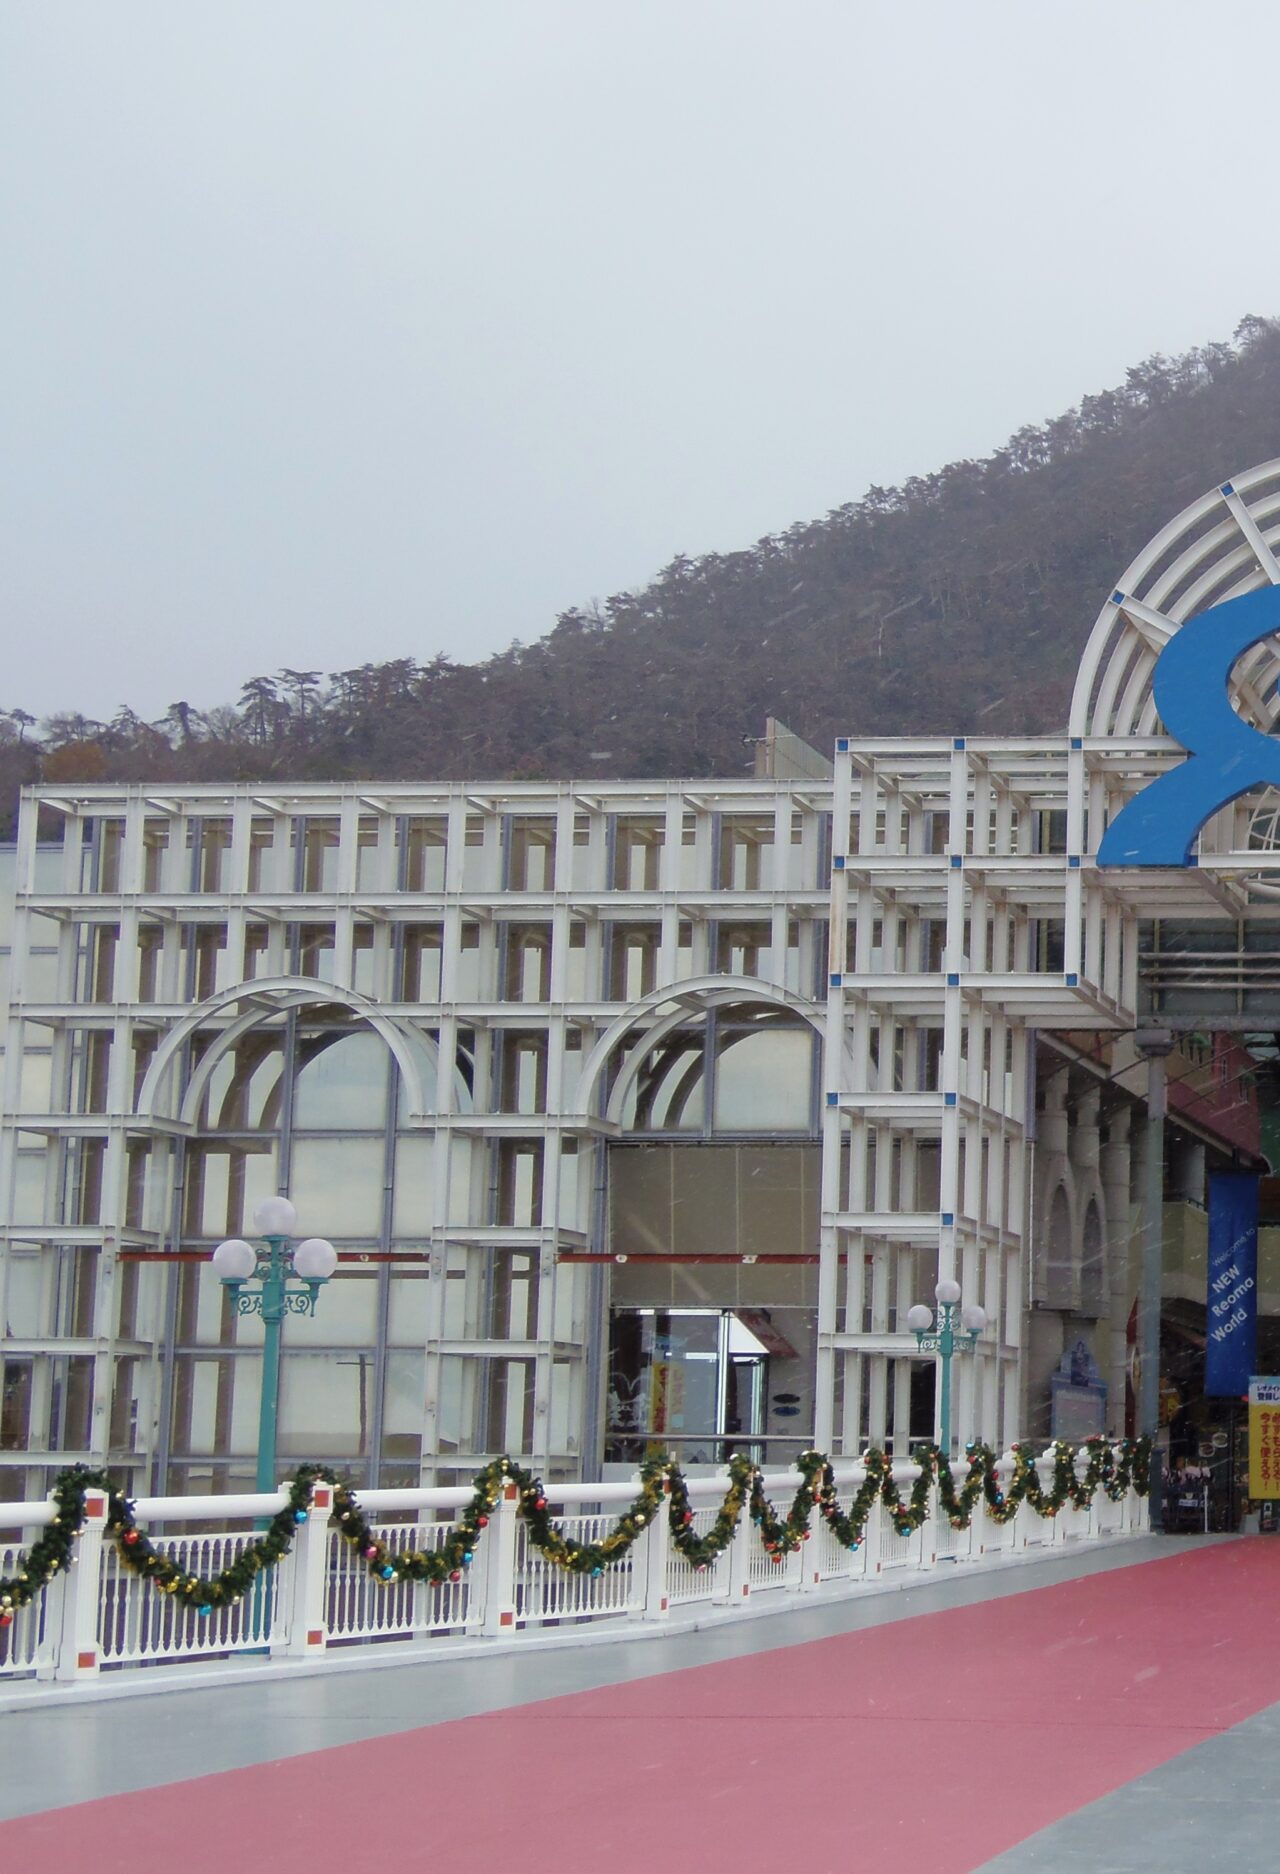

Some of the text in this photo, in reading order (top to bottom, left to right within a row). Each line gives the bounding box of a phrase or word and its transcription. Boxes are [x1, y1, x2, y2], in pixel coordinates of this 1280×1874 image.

[1212, 1227, 1256, 1266] Welcome to
[1211, 1264, 1240, 1293] NEW
[1211, 1277, 1255, 1317] Reoma
[1210, 1308, 1248, 1342] World
